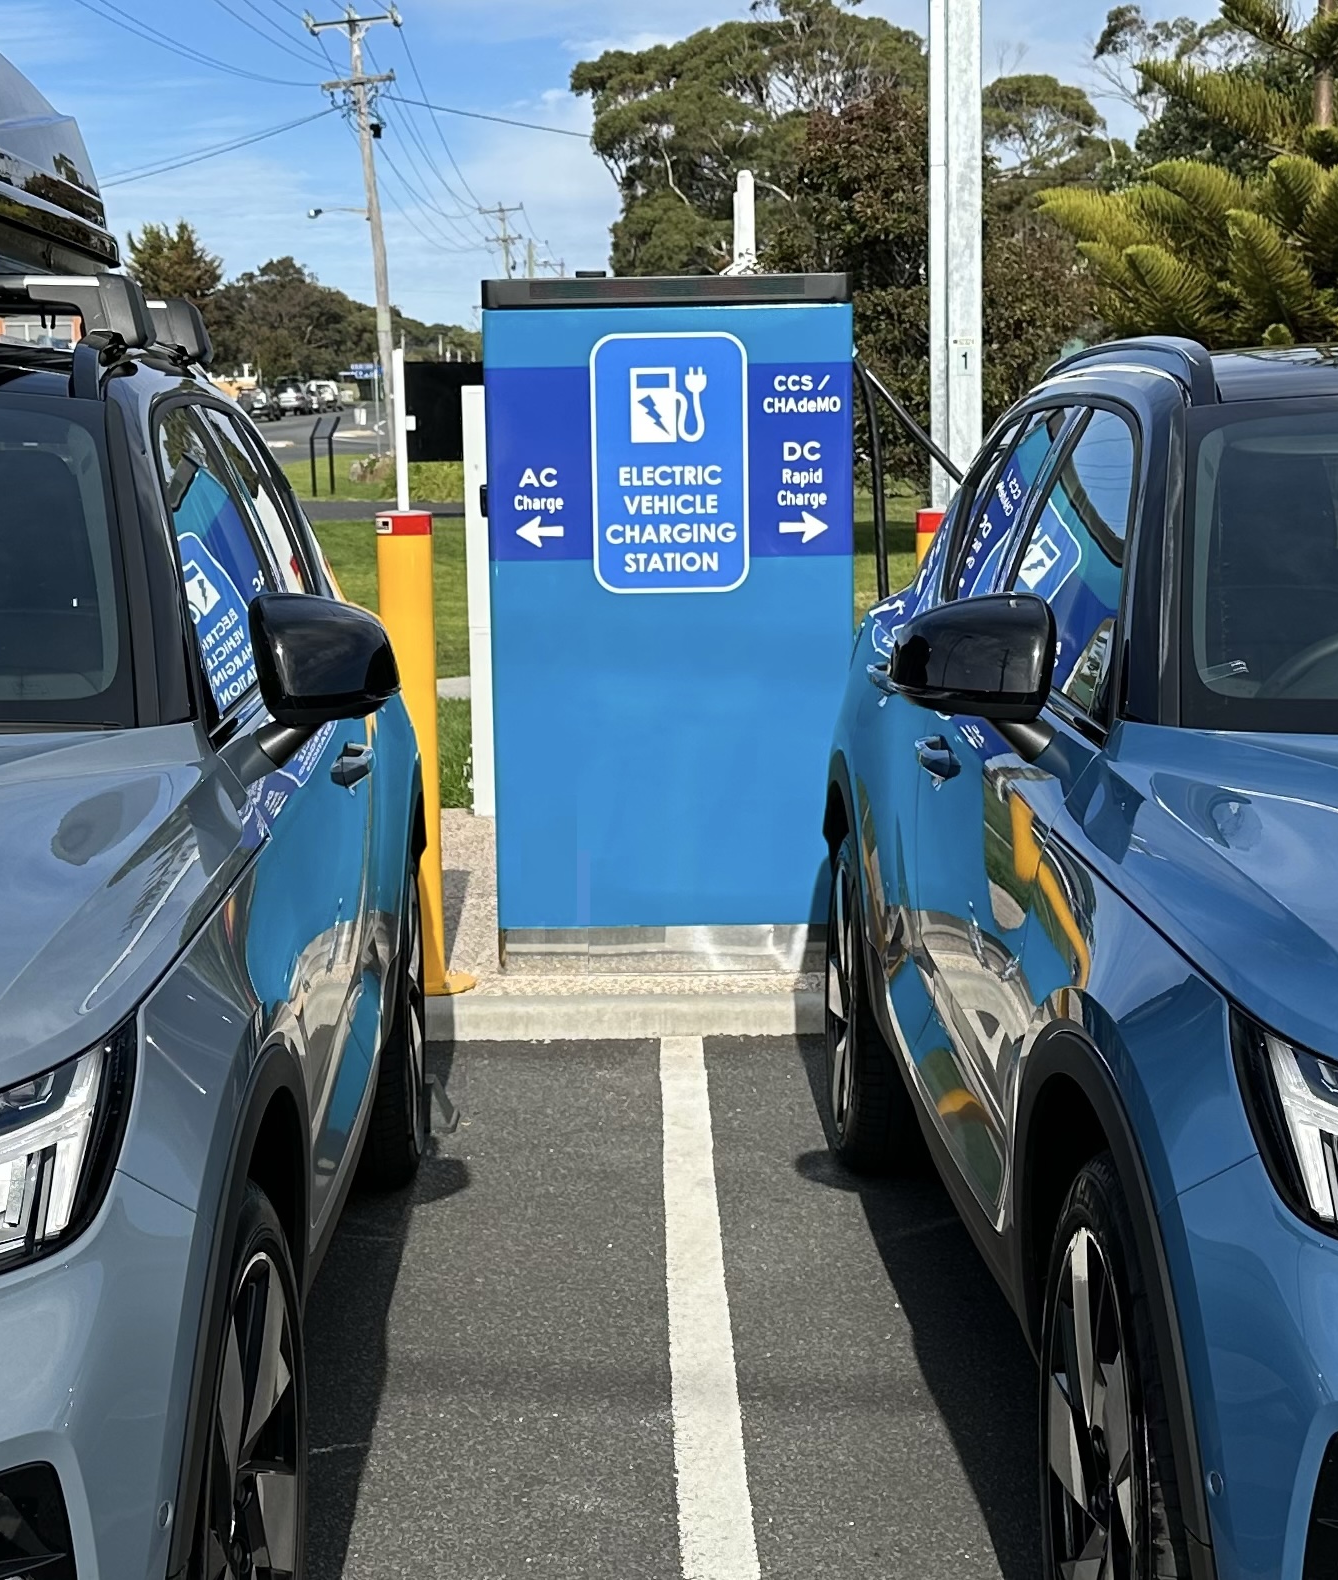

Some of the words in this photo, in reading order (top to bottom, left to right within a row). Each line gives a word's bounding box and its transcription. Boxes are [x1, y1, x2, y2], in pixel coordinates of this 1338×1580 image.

[774, 375, 813, 391] CCS
[763, 396, 841, 413] CHAdeMO
[783, 441, 821, 461] DC
[519, 468, 558, 487] AC
[619, 465, 722, 486] ELECTRIC
[782, 468, 823, 487] Rapid
[514, 495, 563, 513] Charge
[624, 495, 718, 515] VEHICLE
[777, 490, 827, 509] Charge
[606, 523, 737, 544] CHARGING
[625, 552, 719, 572] STATION
